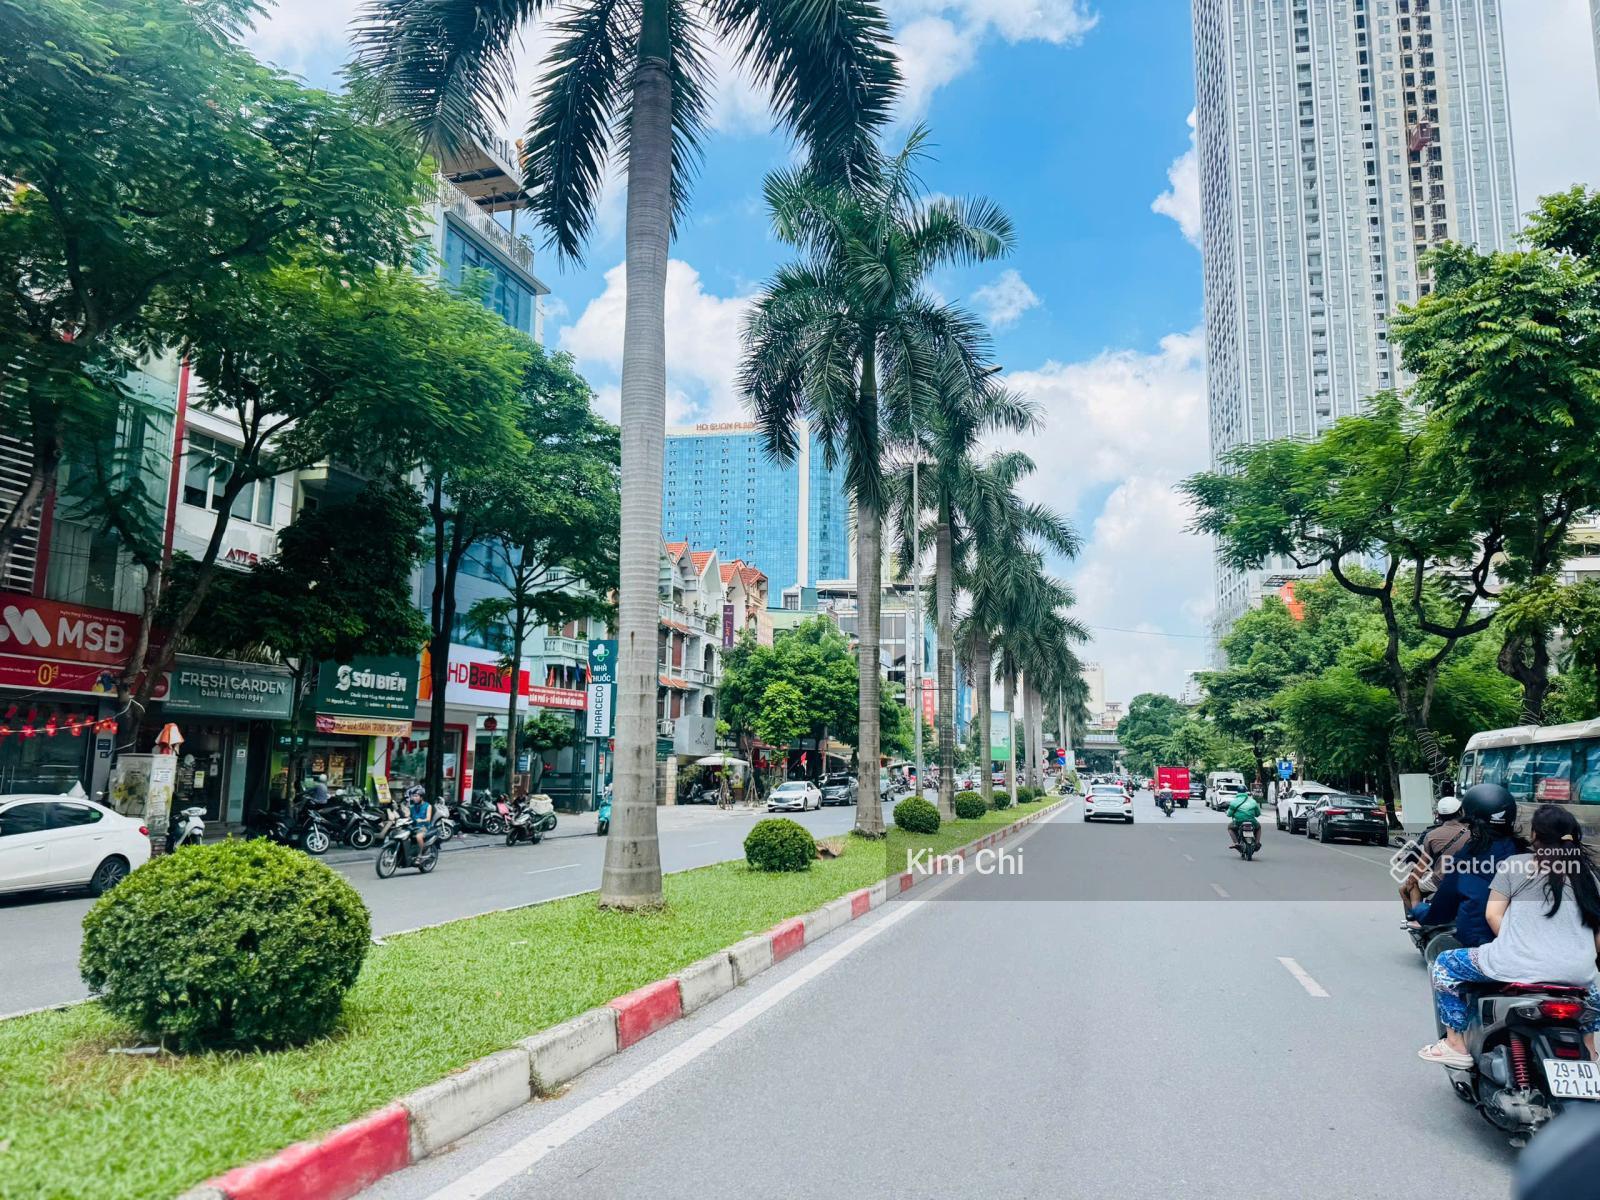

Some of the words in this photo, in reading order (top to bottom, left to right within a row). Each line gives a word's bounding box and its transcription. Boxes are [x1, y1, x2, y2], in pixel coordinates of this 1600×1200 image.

[57, 617, 125, 654] MSB
[447, 662, 503, 689] HDBank
[593, 664, 607, 672] NHÀ
[179, 671, 228, 689] FRESH
[230, 677, 286, 695] GARDEN
[594, 685, 604, 735] PHARCECO
[1553, 1063, 1593, 1079] 29-AD
